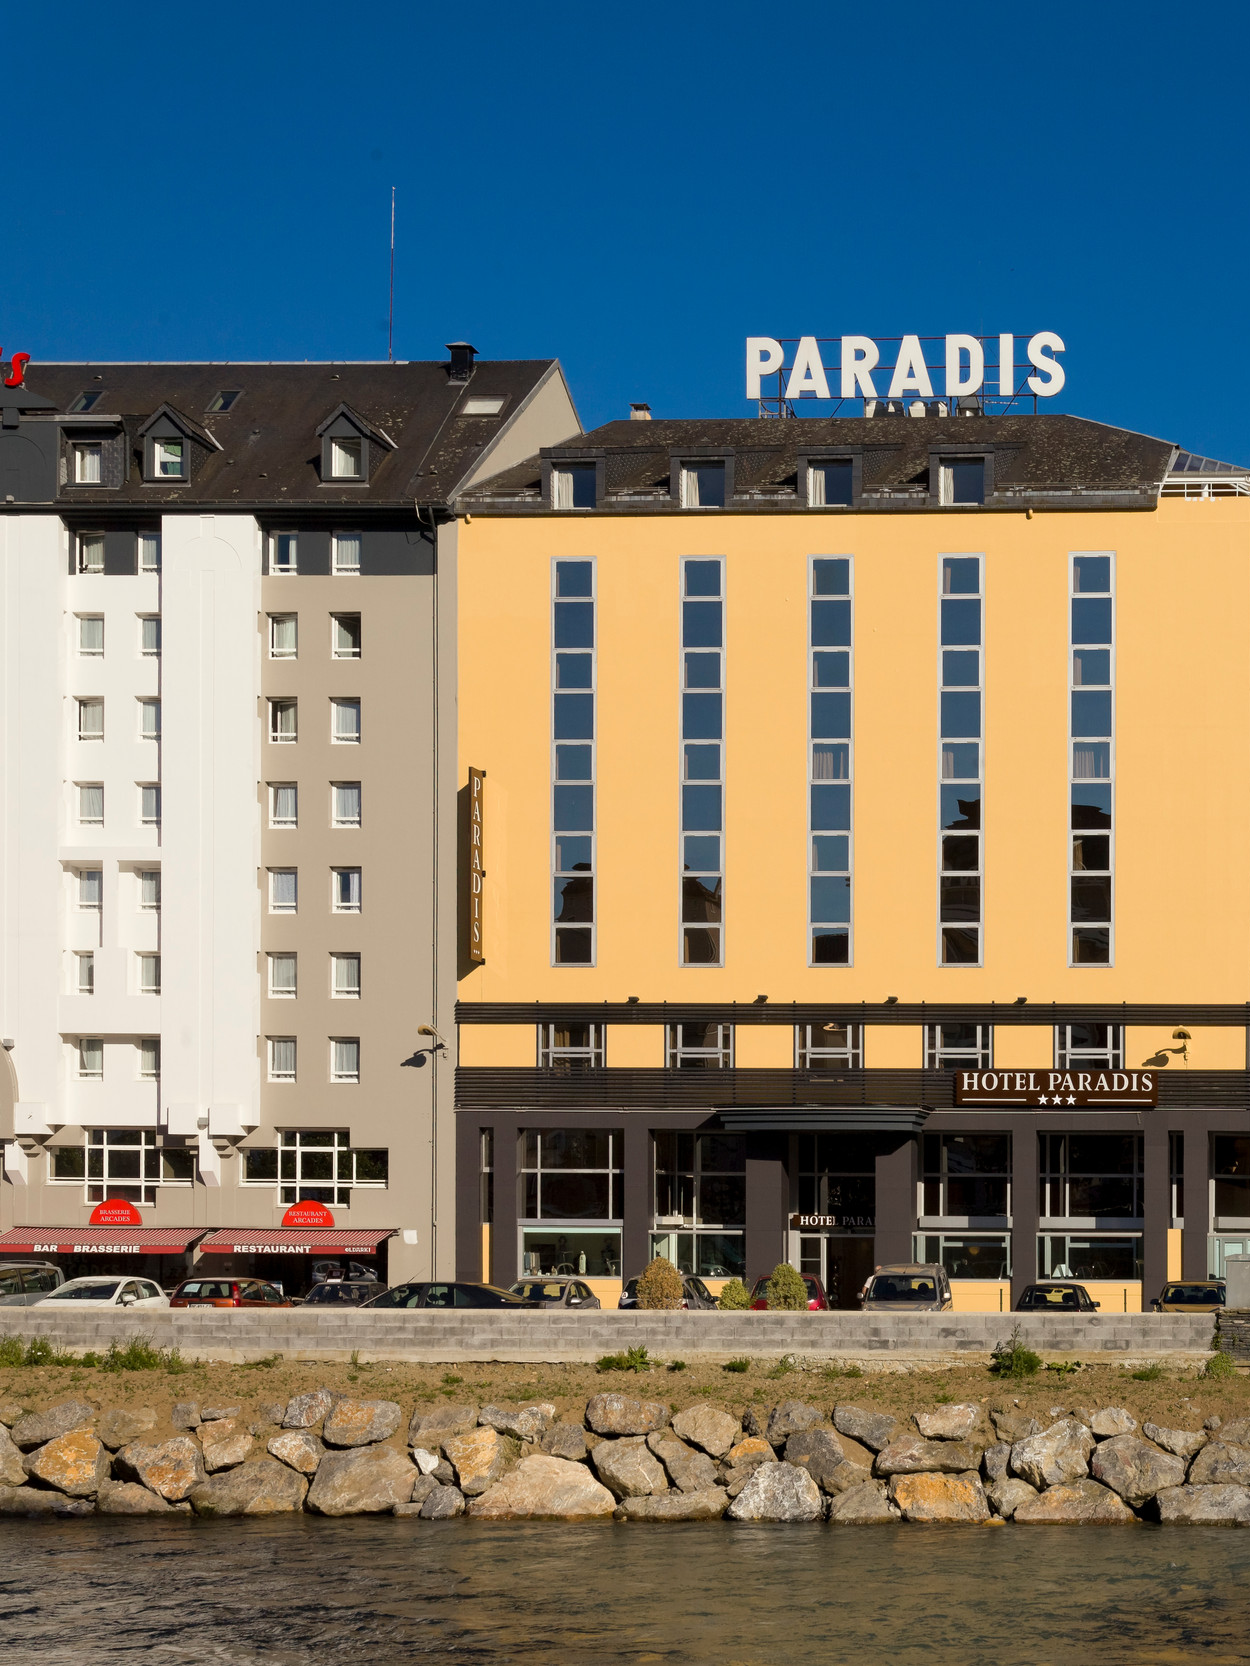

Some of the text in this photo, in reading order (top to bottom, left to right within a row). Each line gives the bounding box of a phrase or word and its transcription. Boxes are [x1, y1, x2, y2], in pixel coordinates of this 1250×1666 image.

[746, 331, 1065, 400] PARADIS
[472, 777, 481, 943] PARADIS
[962, 1072, 1153, 1092] HOTEL PARADIS
[800, 1215, 876, 1226] HOTEL PARA
[33, 1244, 140, 1253] BAR BRASSERIE
[233, 1245, 312, 1254] RESTAURANT
